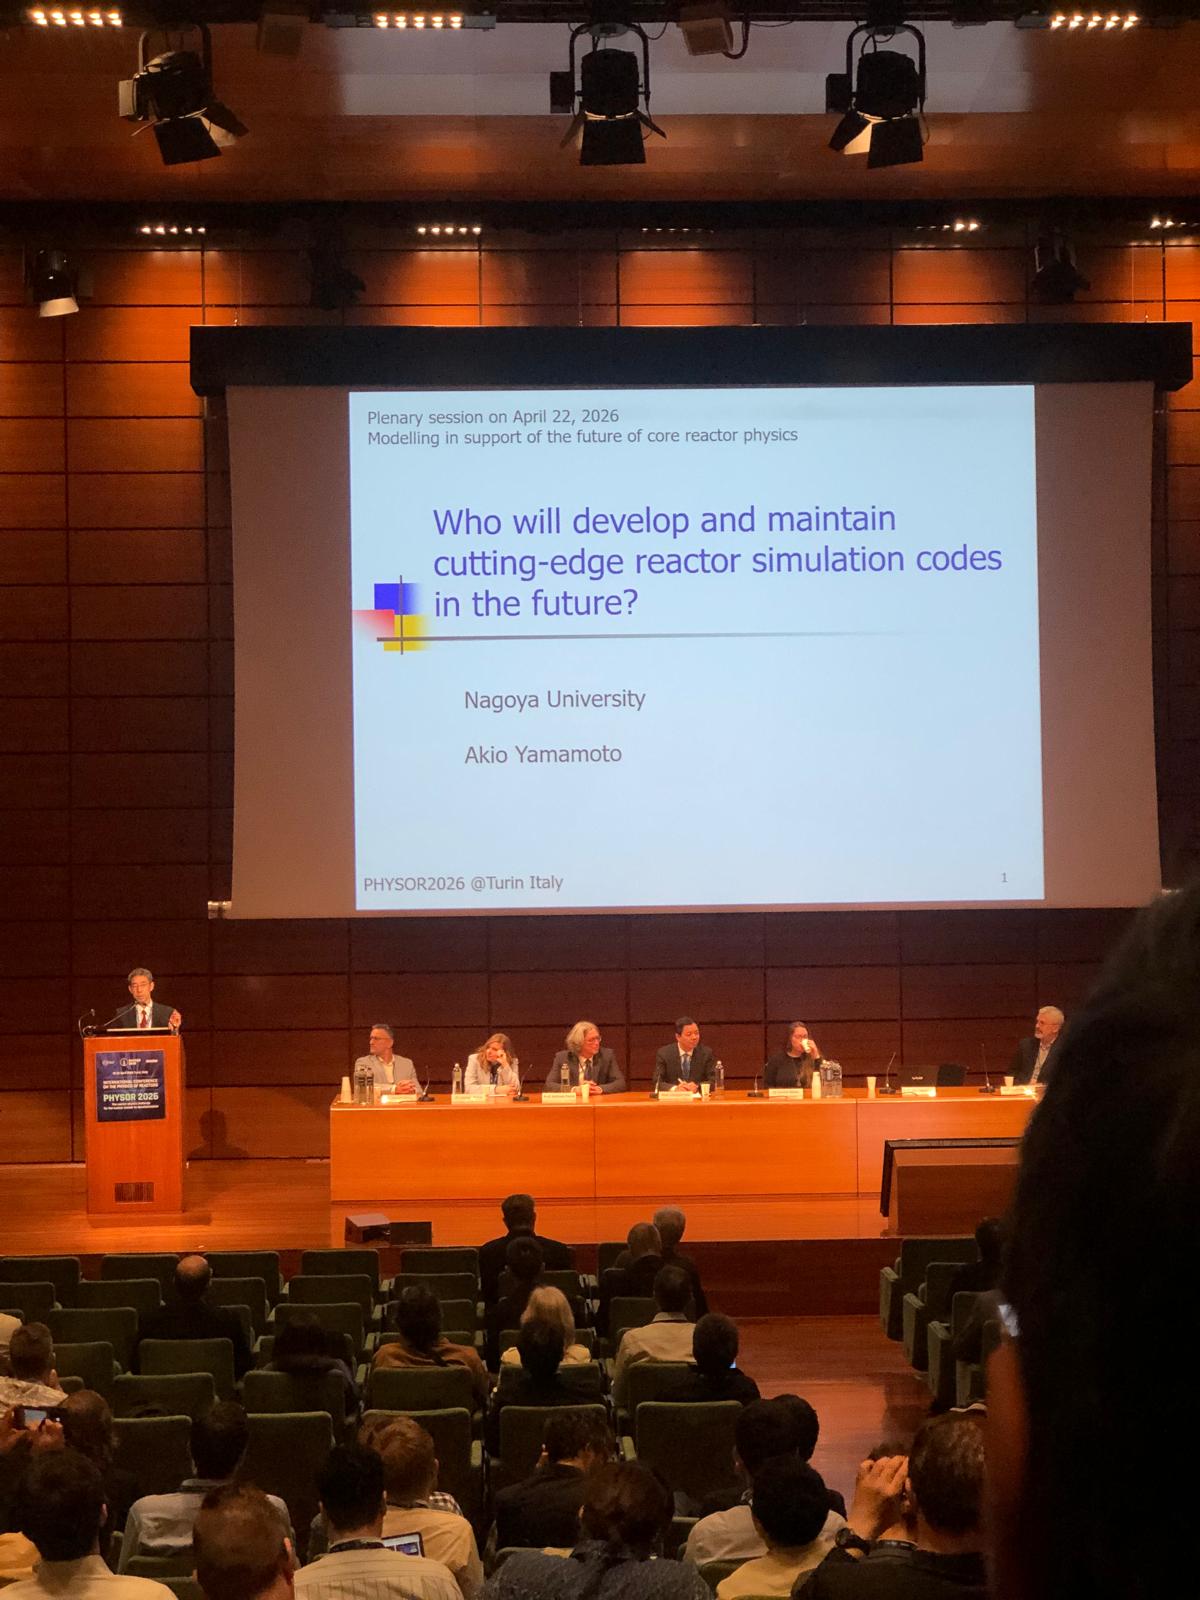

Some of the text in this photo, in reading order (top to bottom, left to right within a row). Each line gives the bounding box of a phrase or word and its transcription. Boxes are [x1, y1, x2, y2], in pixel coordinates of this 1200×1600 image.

[367, 408, 620, 428] Plenary session on April 22, 2026
[367, 427, 799, 448] Modelling in support of the future of core reactor physics
[432, 504, 896, 540] Who will develop and maintain
[433, 543, 1003, 582] cutting-edge reactor simulation codes
[435, 587, 639, 618] in the future?
[464, 688, 647, 714] Nagoya University
[464, 744, 623, 765] Akio Yamamoto
[363, 874, 564, 893] PHYSOR2026 @Turin Italy
[1002, 872, 1008, 883] 1
[103, 1092, 159, 1101] PHYSOR 2026
